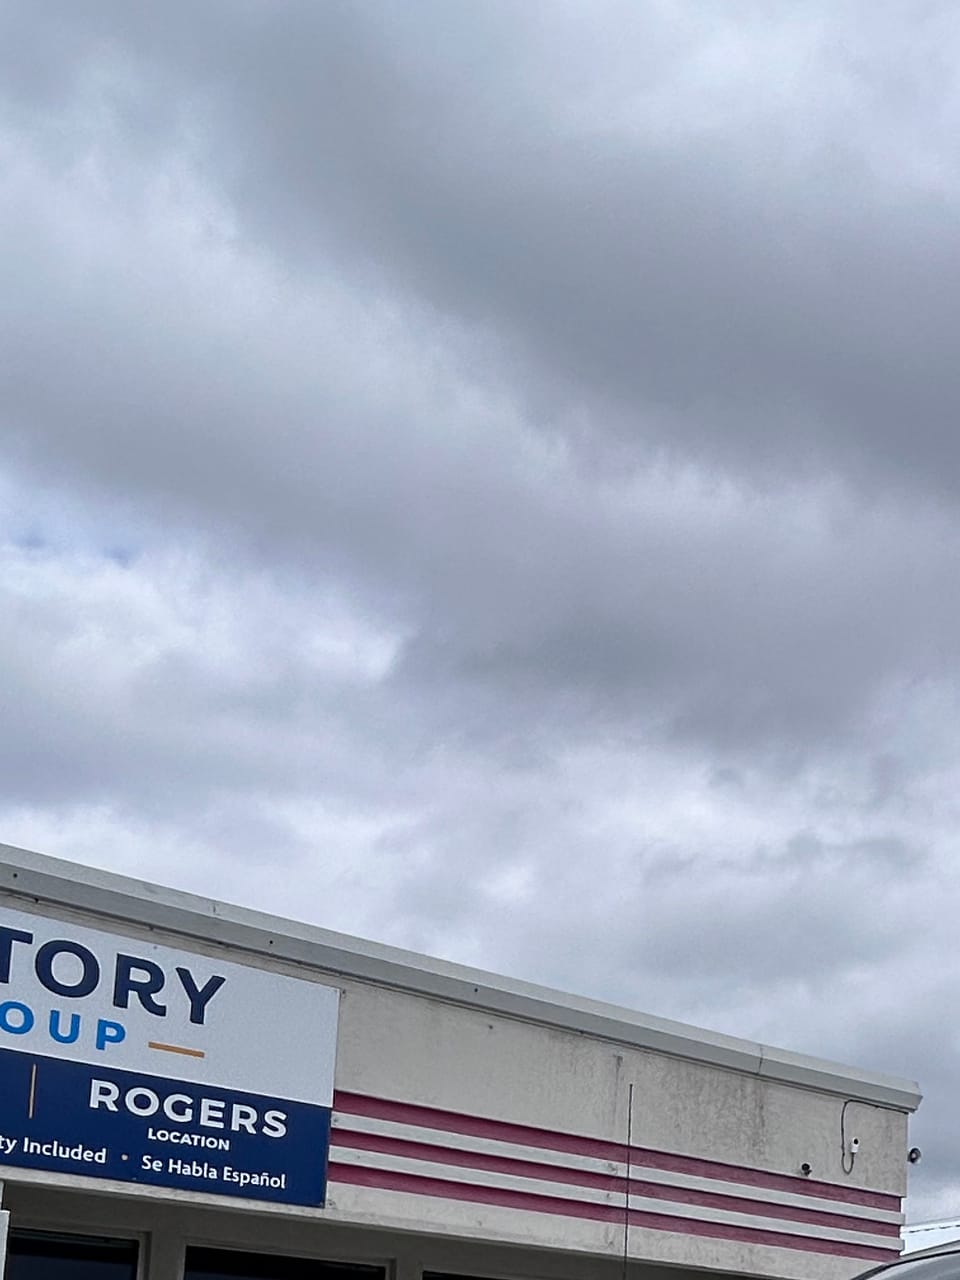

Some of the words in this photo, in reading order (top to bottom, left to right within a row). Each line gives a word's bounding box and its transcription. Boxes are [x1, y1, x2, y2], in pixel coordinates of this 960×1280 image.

[0, 1001, 126, 1050] OUP
[89, 1079, 287, 1138] ROGERS
[23, 1137, 107, 1164] Included
[141, 1155, 163, 1171] Se
[168, 1158, 218, 1180] Habla
[223, 1166, 286, 1189] Español
[148, 1127, 230, 1151] LOCATION
